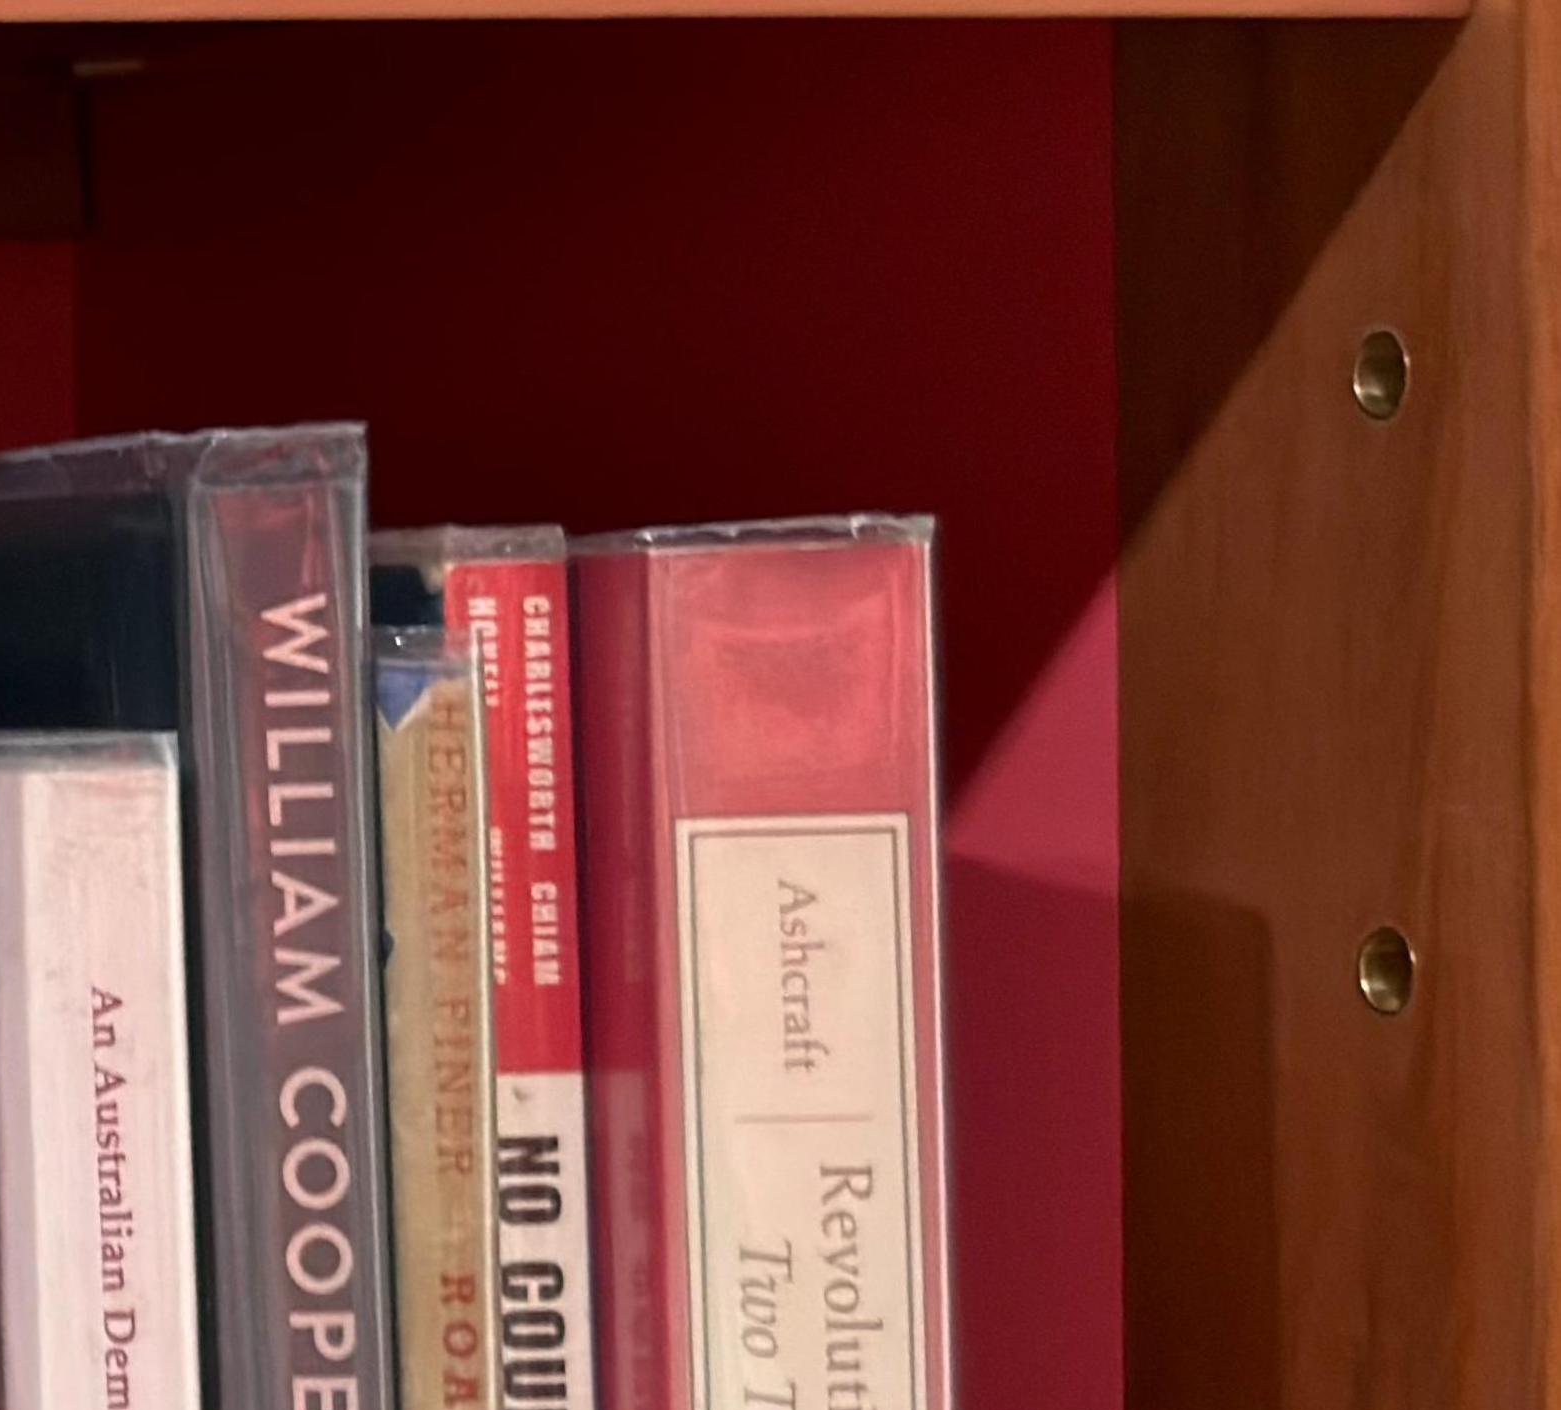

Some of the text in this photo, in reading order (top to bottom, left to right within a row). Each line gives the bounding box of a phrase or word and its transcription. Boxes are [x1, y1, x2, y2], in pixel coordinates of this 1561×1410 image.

[261, 594, 343, 1025] WILLIAM
[523, 595, 562, 987] CHARLESWORTH CHIAM
[778, 879, 830, 1072] Ashcraft
[497, 1136, 561, 1226] NO
[738, 1241, 792, 1359] Two
